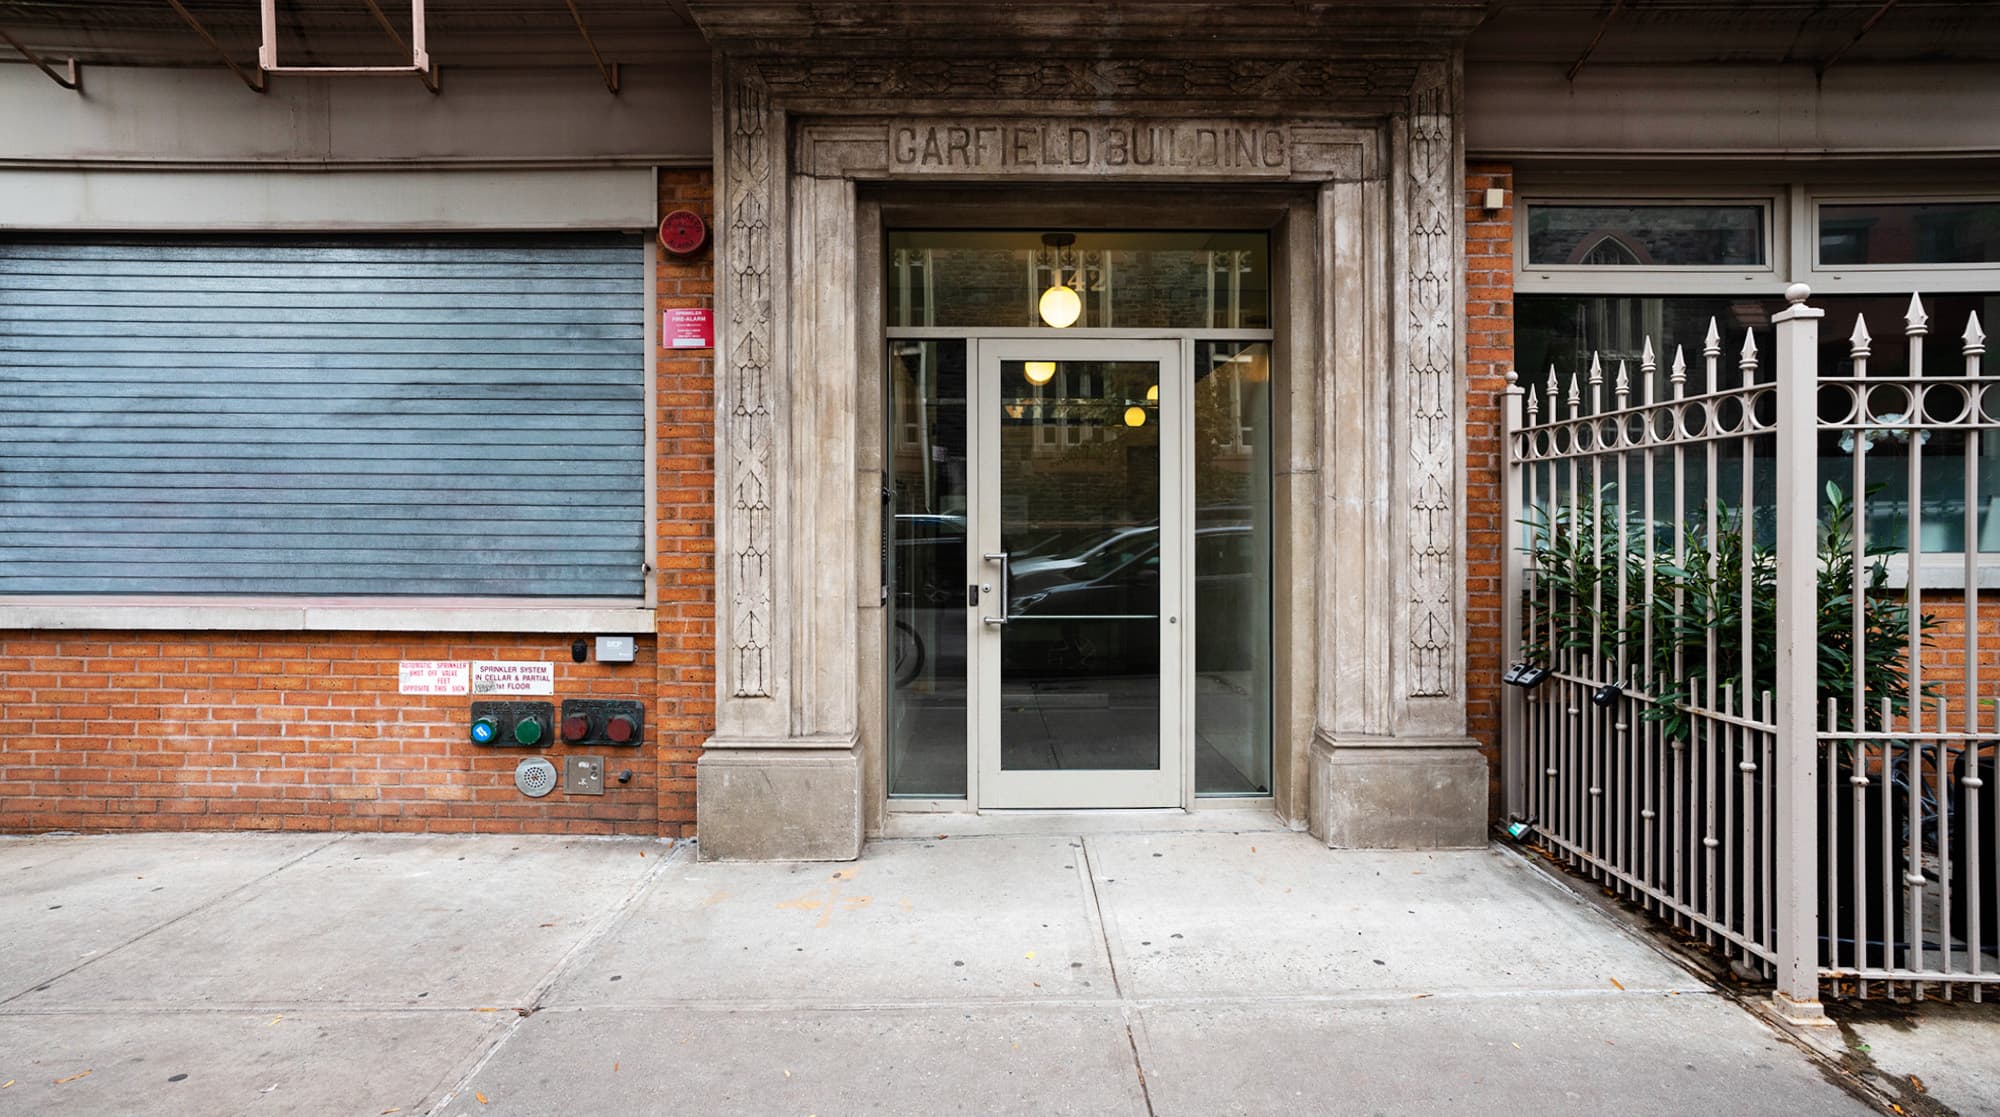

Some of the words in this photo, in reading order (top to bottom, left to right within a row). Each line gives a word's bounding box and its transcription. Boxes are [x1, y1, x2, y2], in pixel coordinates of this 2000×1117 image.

[894, 125, 1092, 167] GARFIELD
[1105, 126, 1286, 168] BUILDING
[1051, 268, 1106, 292] 142
[480, 665, 517, 673] SPRINKLER
[522, 674, 550, 682] PARTIAL
[507, 682, 531, 690] FLOOR
